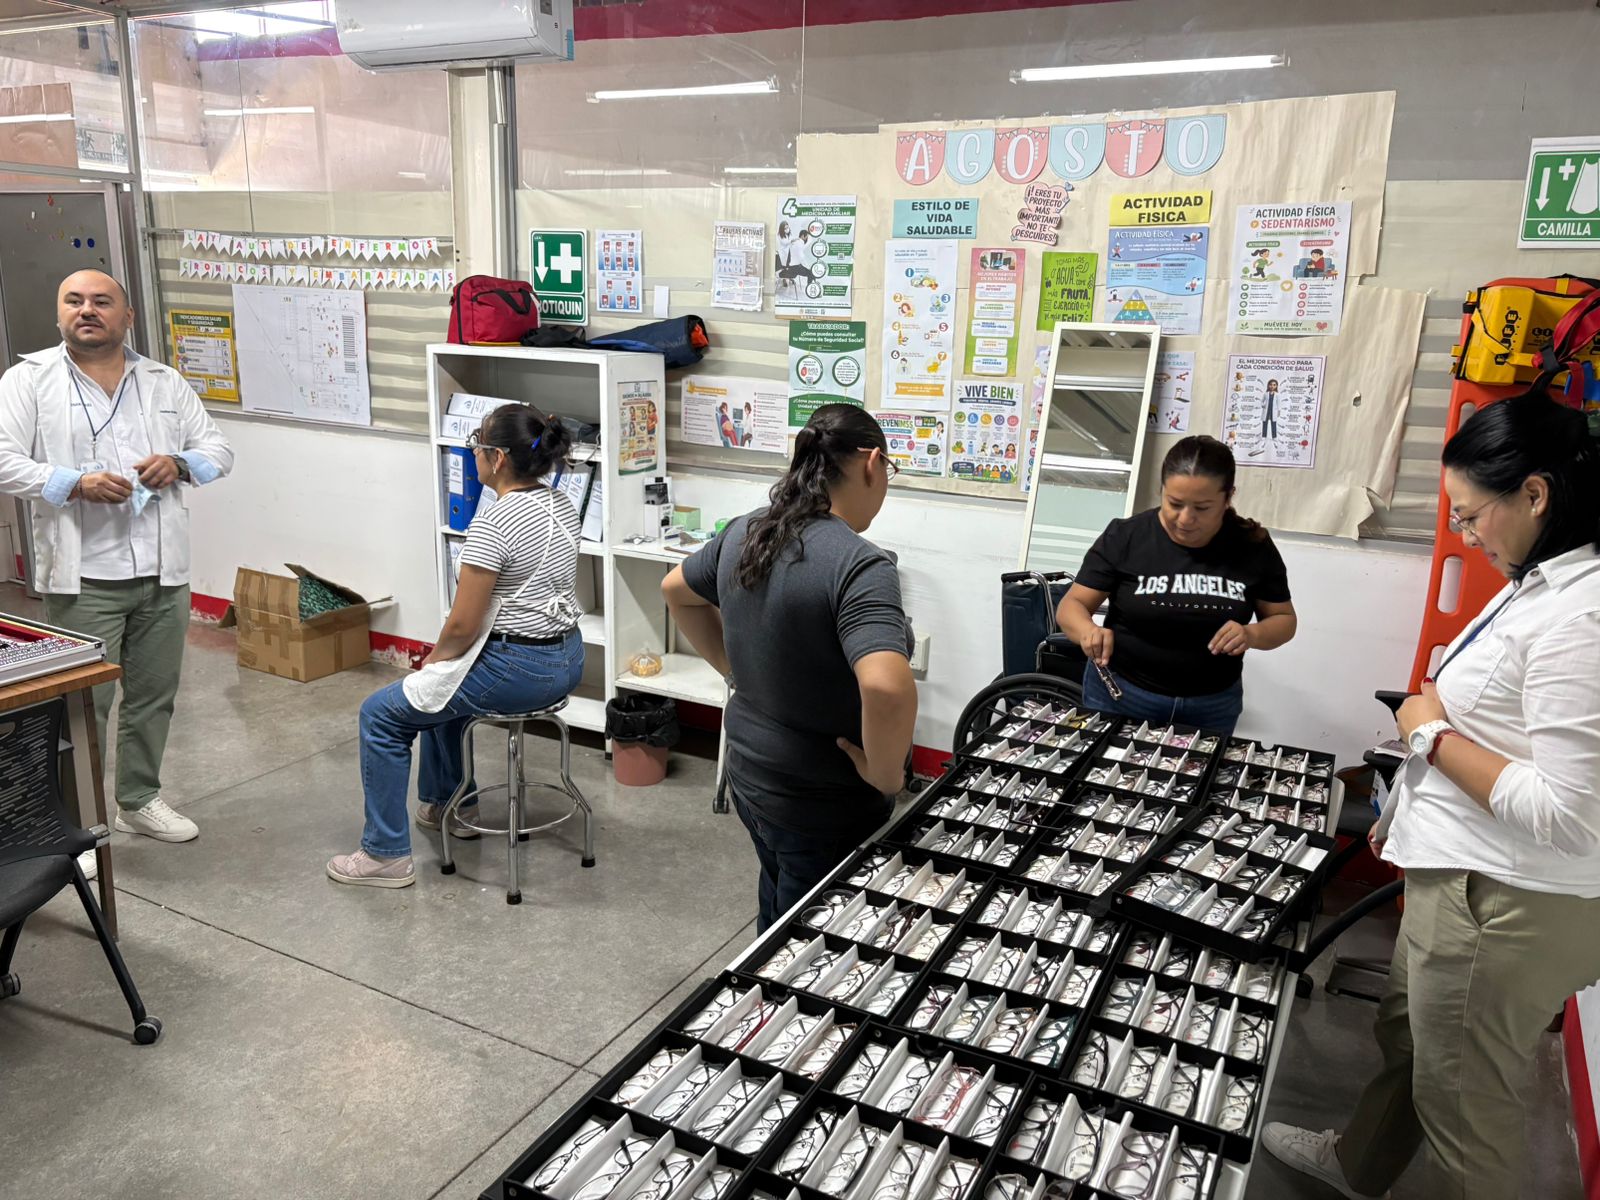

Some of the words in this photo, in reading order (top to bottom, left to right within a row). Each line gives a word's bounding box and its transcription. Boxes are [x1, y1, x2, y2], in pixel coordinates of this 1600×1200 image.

[906, 119, 1208, 181] AGOSTO
[1035, 189, 1052, 198] ERES
[1053, 191, 1062, 199] TU
[912, 202, 951, 212] ESTILO
[954, 202, 970, 211] DE
[1029, 197, 1062, 208] PROYECTO
[1123, 196, 1204, 210] ACTIVIDAD
[1138, 212, 1186, 223] FISICA
[1256, 208, 1304, 218] ACTIVIDAD
[1306, 205, 1336, 217] FÍSICA
[926, 214, 953, 223] VIDA
[1261, 218, 1336, 229] SEDENTARISMO
[906, 224, 972, 236] SALUDABLE
[1026, 222, 1038, 230] NO
[1040, 224, 1048, 232] TE
[1537, 222, 1591, 236] CAMILLA
[187, 233, 216, 242] LAY
[236, 240, 268, 250] AUT
[288, 240, 308, 250] DE
[331, 238, 434, 252] ENFERMOS
[183, 261, 268, 276] CRONICOS
[288, 268, 295, 276] Y
[314, 270, 454, 282] EMBARAZADAS
[1061, 288, 1091, 300] FRUTA.
[965, 385, 988, 397] VIVE
[990, 386, 1014, 399] BIEN
[878, 419, 913, 428] REVENIMSS
[1134, 575, 1169, 595] LOS
[1171, 574, 1246, 602] ANGELES
[1152, 600, 1232, 610] CALIFORNIA
